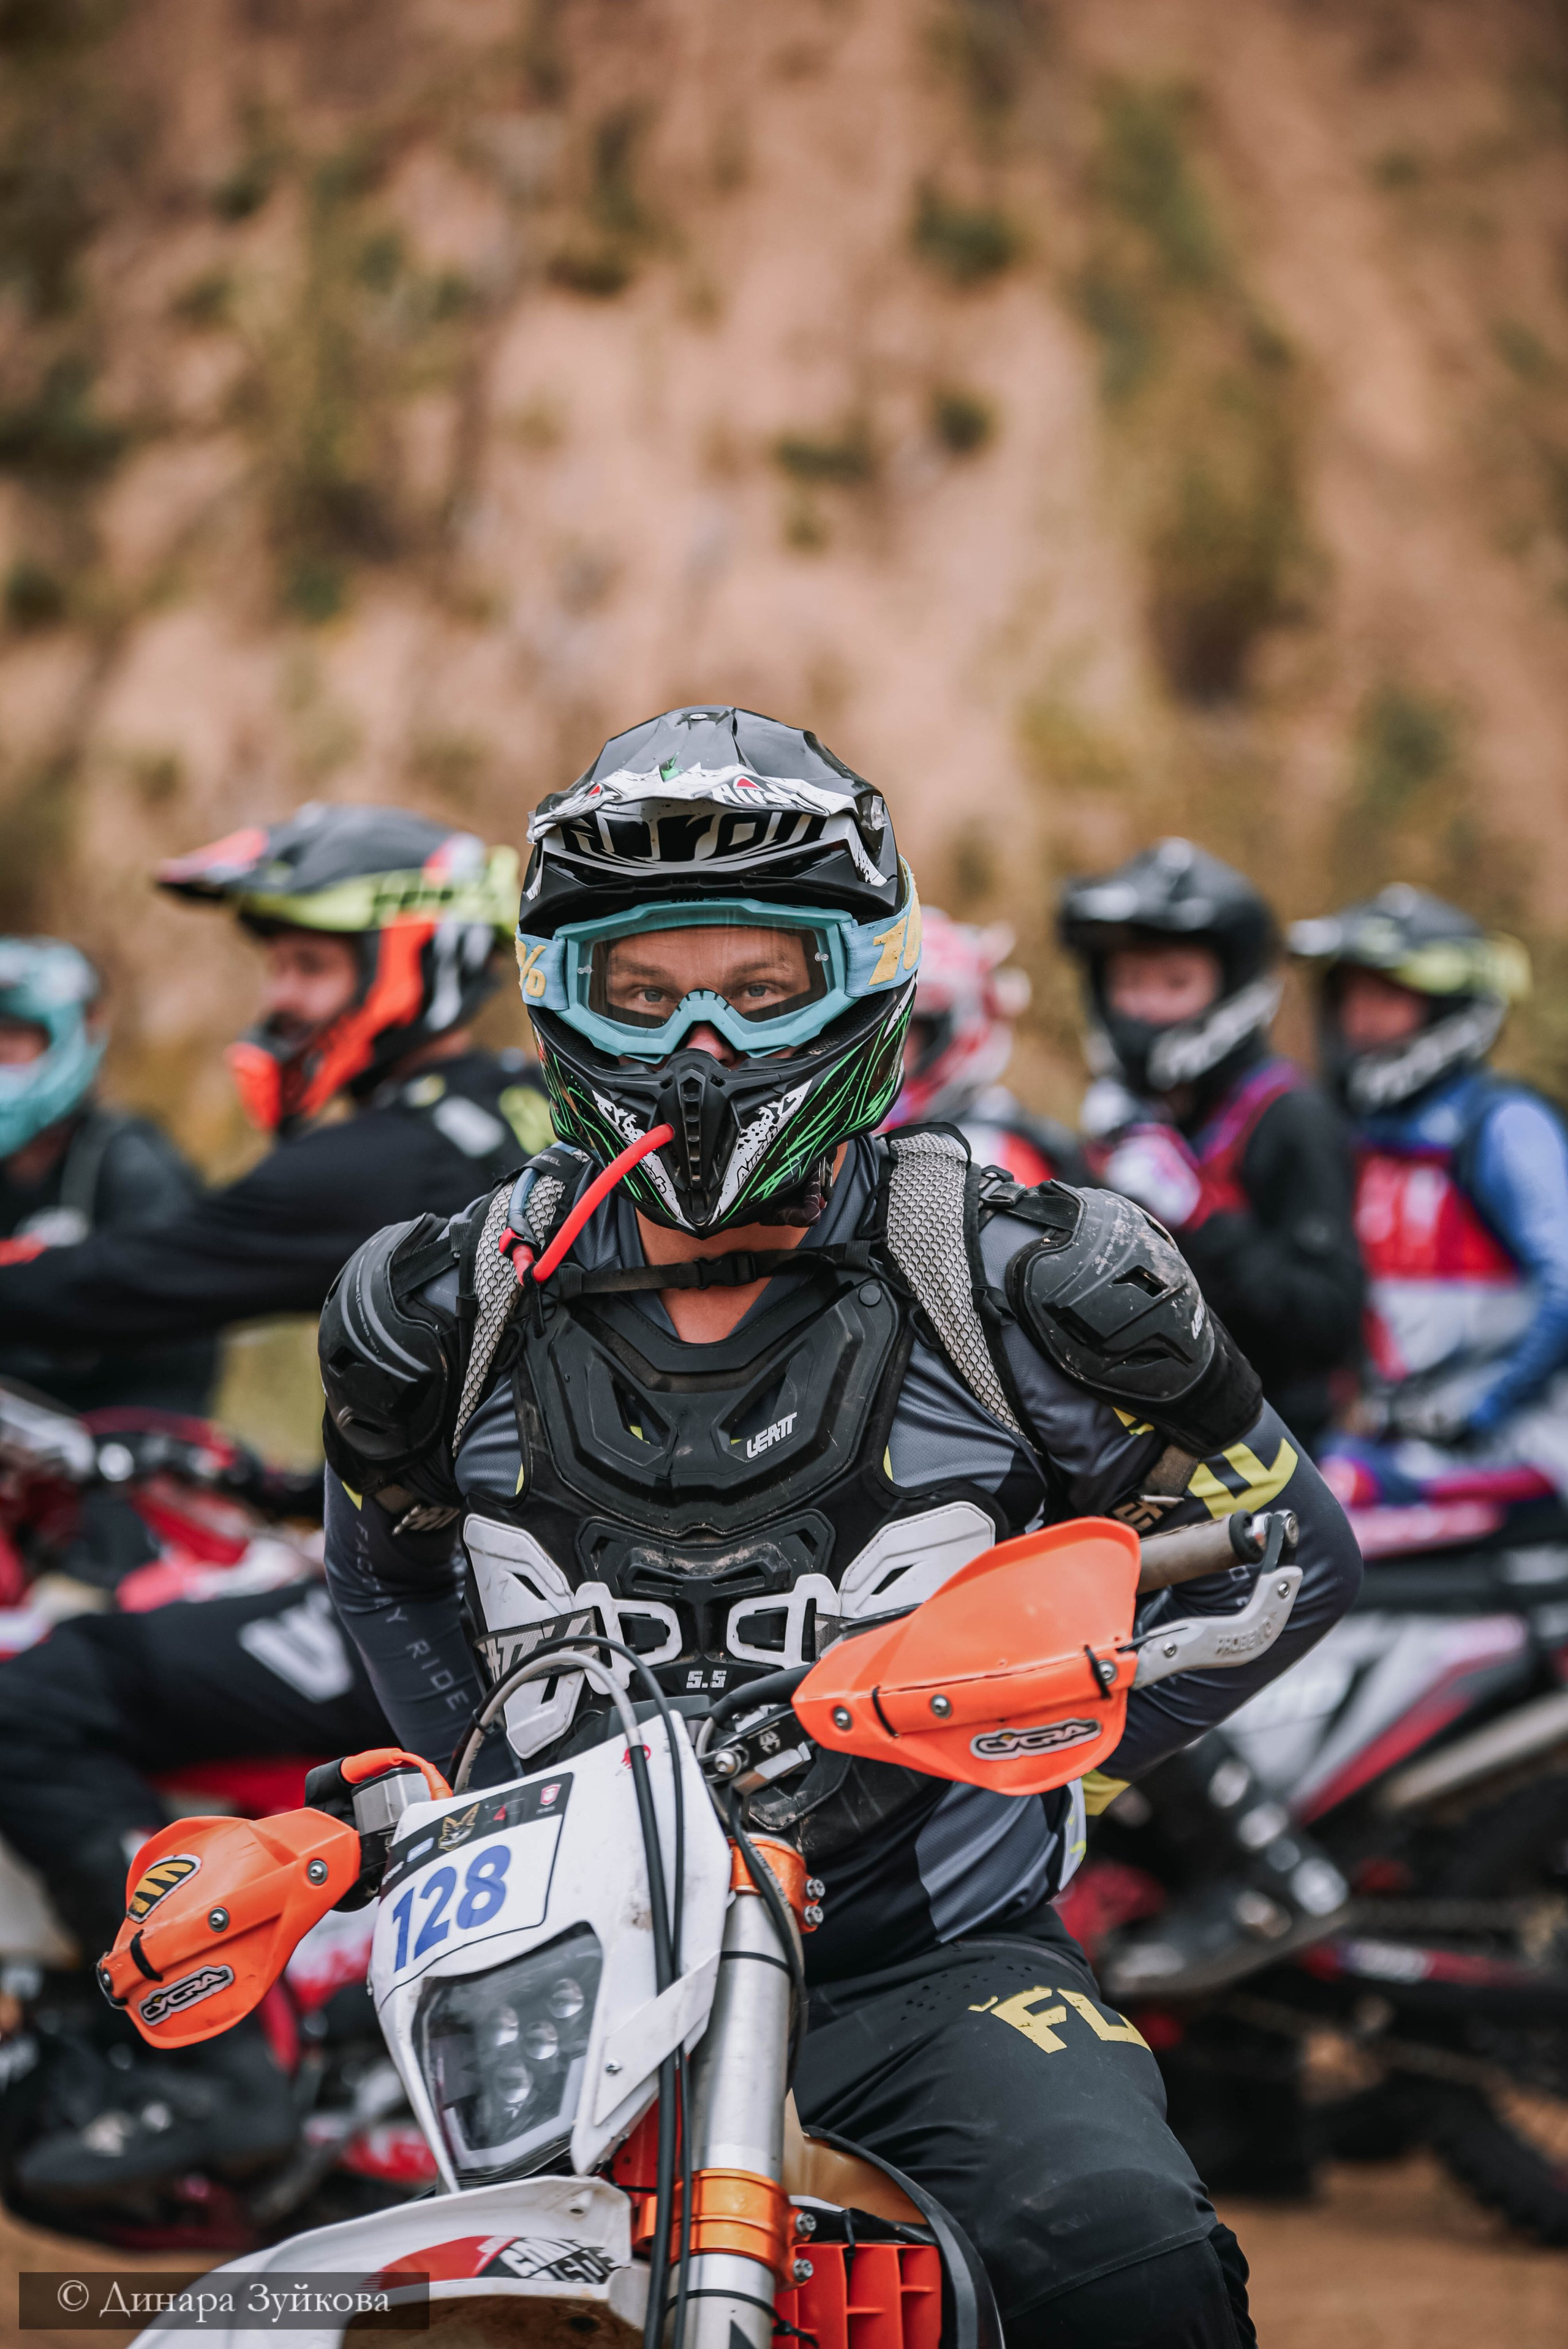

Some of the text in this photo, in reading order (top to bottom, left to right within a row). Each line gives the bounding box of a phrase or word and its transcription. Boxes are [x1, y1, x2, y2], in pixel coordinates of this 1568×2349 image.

[737, 1125, 778, 1190] Airoh
[747, 1411, 797, 1458] LEATT
[405, 1639, 469, 1711] RIDE
[686, 1670, 727, 1689] 5.5
[392, 1844, 511, 1974] 128
